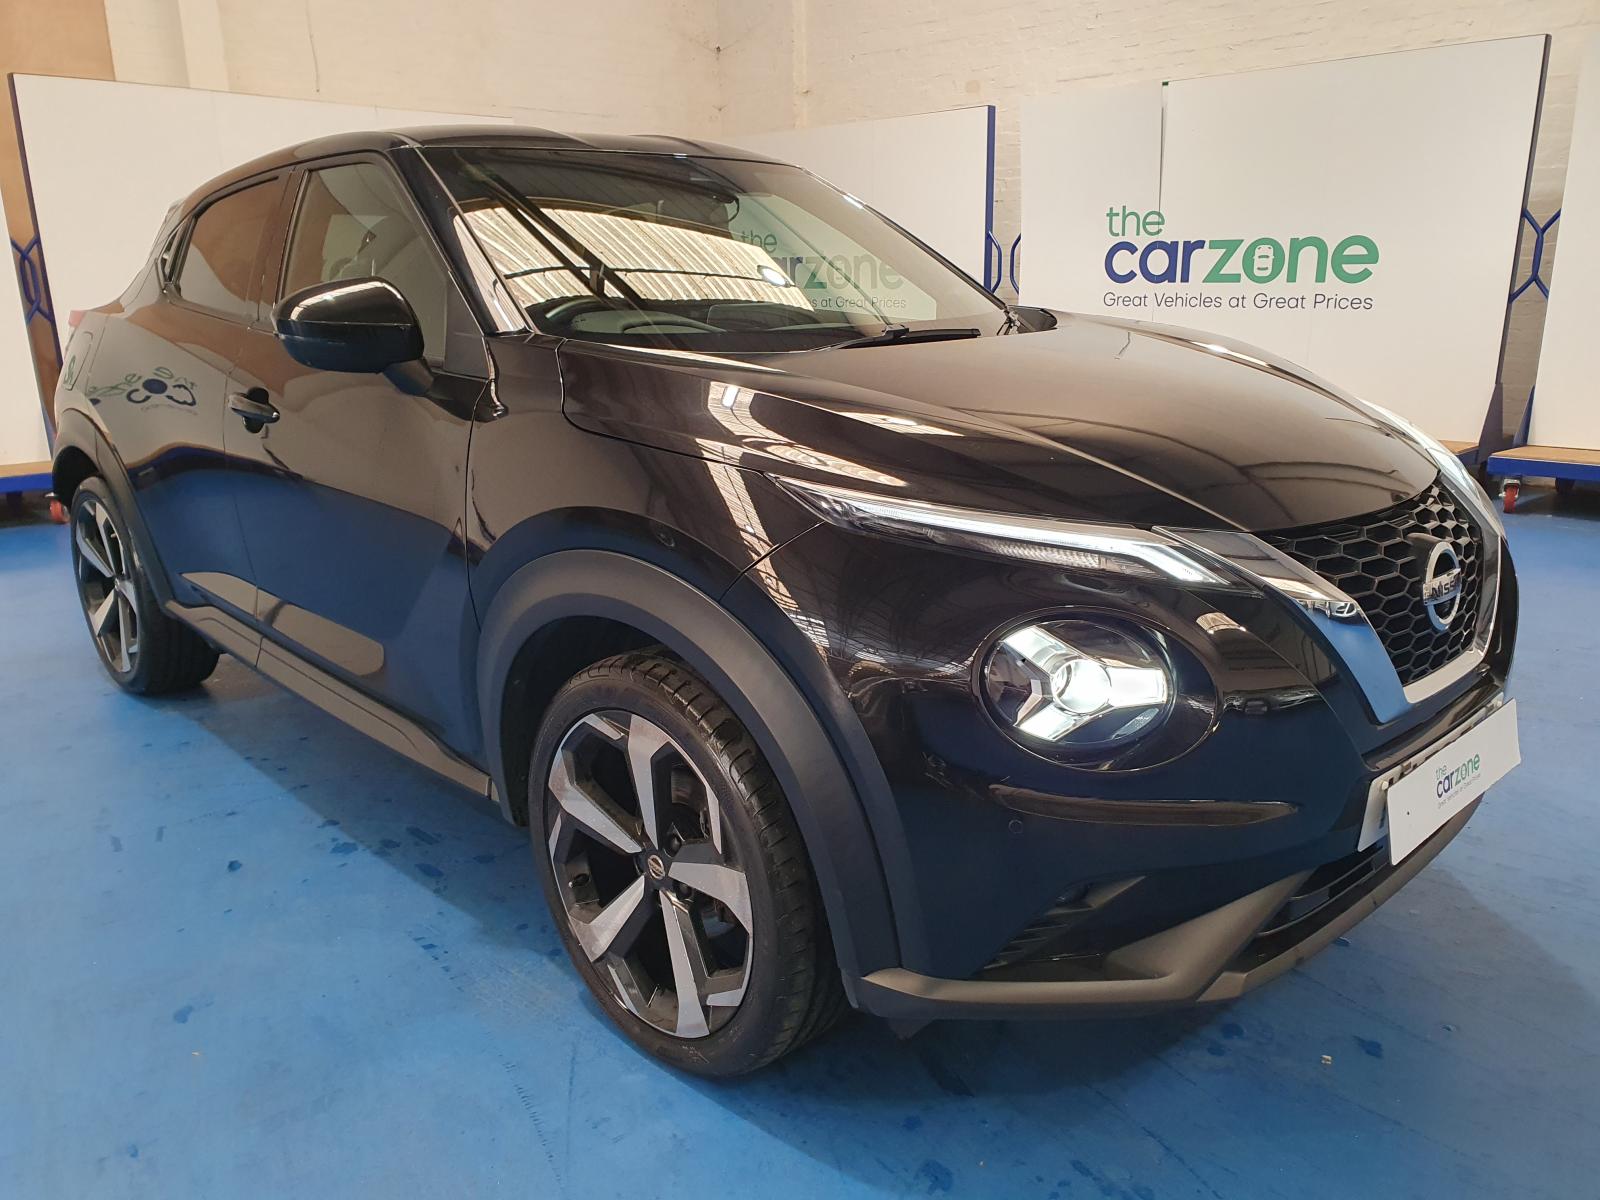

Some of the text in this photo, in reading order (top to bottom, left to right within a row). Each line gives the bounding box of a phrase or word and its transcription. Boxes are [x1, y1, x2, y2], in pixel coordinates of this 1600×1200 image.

[1105, 205, 1165, 237] the
[771, 253, 905, 290] rzone
[1104, 234, 1380, 284] carzone
[821, 297, 832, 308] at
[1103, 291, 1374, 310] Great Vehicles at Great Prices
[1437, 753, 1480, 799] carzone
